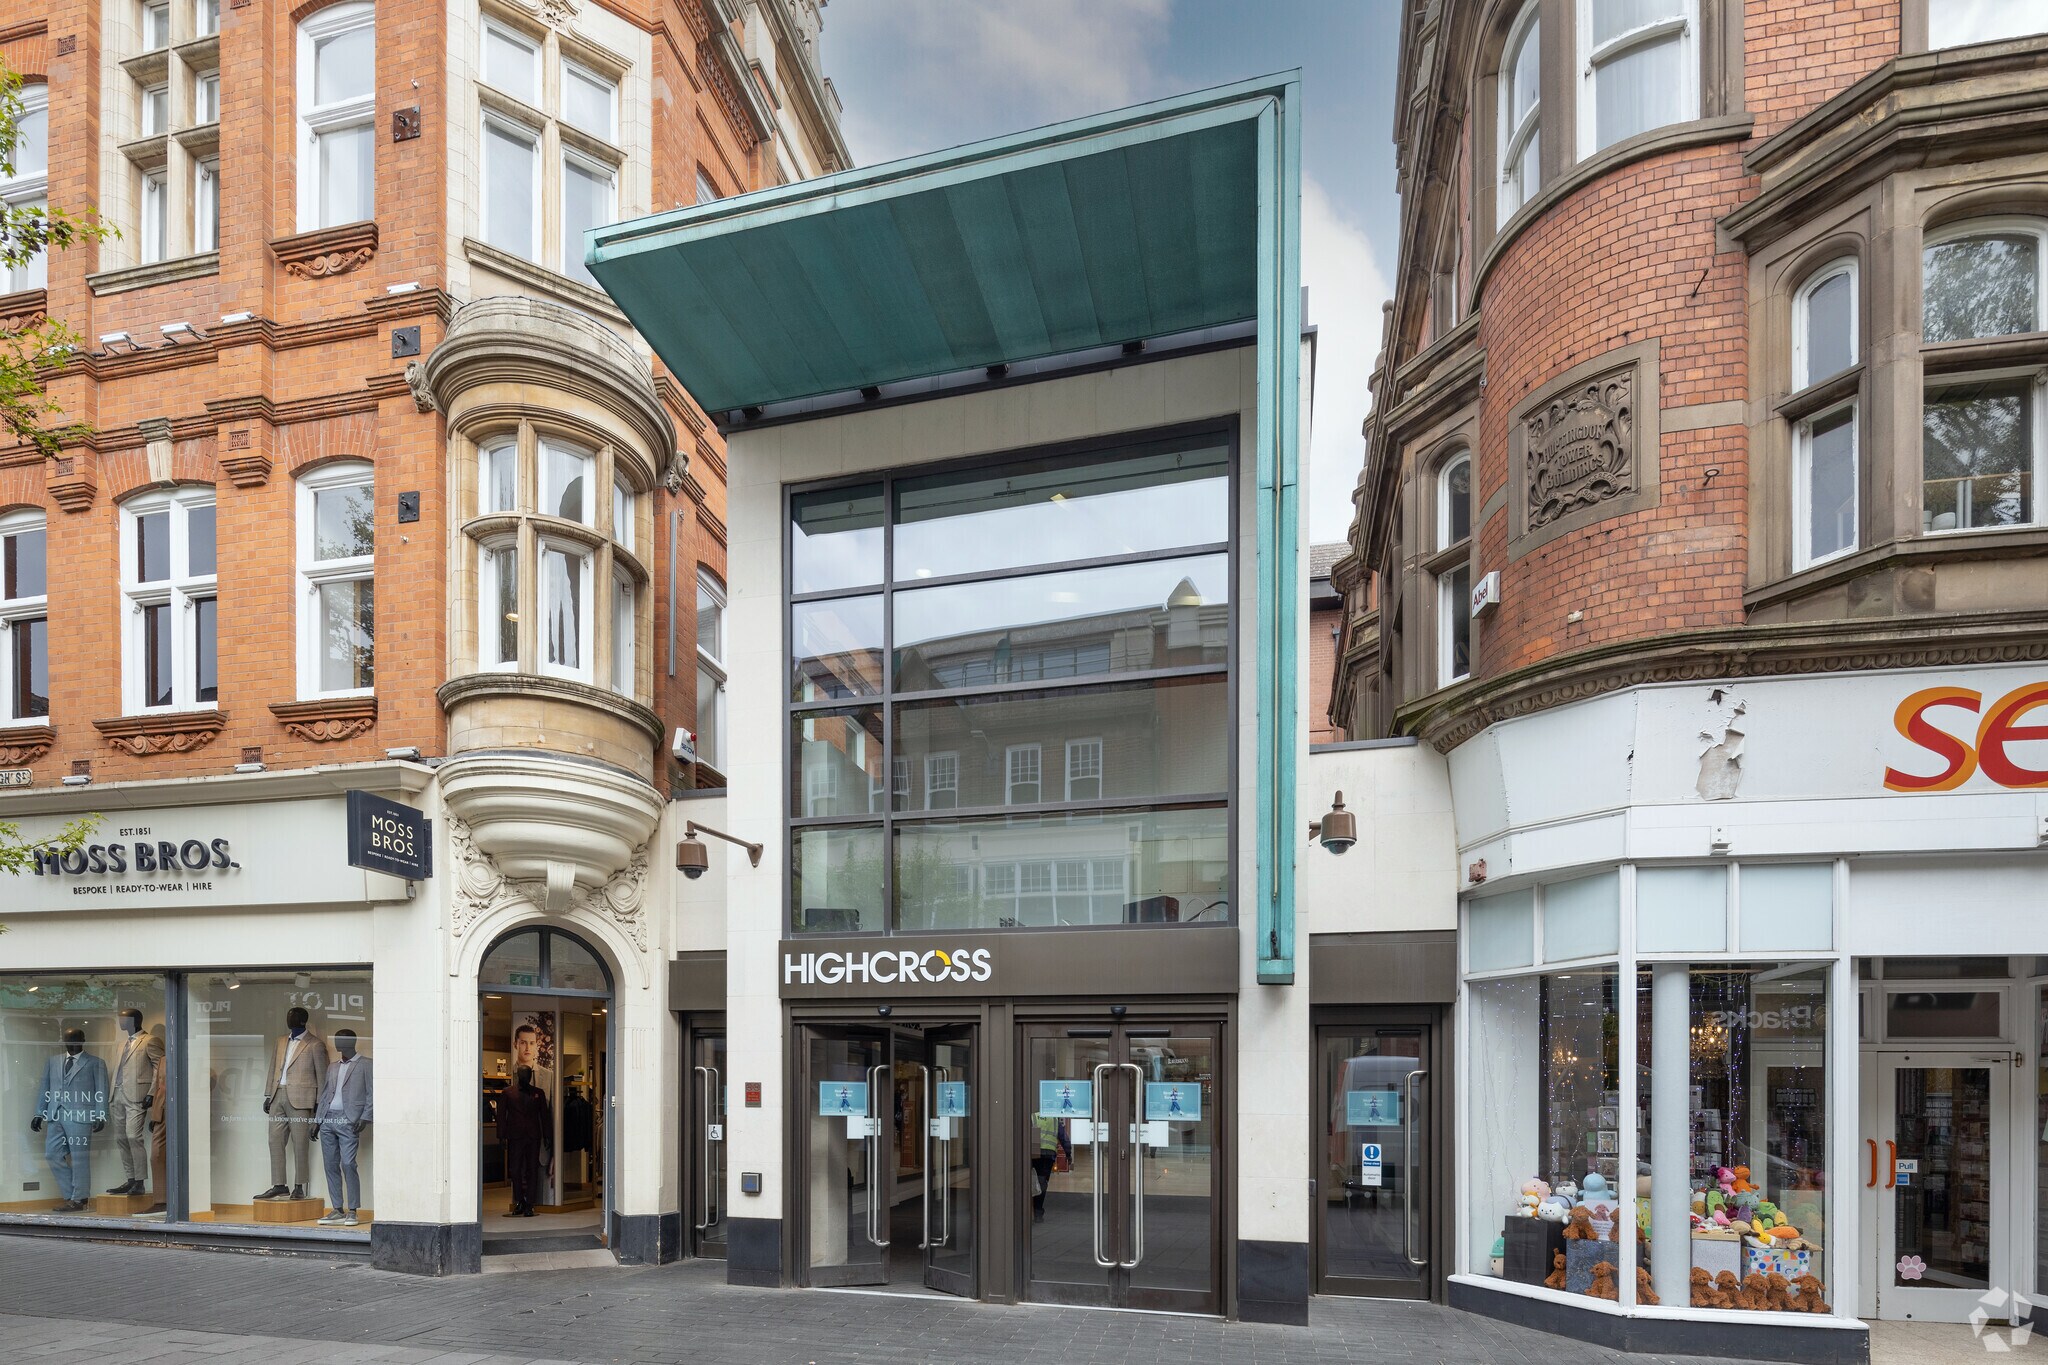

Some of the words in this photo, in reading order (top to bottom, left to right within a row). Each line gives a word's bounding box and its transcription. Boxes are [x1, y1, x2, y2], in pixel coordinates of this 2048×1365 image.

[1543, 424, 1606, 463] HUNTINGDON
[1555, 445, 1592, 471] TOWER
[1546, 454, 1605, 489] BUILDINGS
[1473, 582, 1488, 609] Abel
[119, 827, 151, 837] EST.1851
[372, 814, 413, 839] MOSS
[33, 843, 127, 876] MOSS
[135, 838, 241, 872] BROS.
[367, 850, 382, 858] BESPOKE
[372, 832, 418, 858] BROS.
[73, 885, 107, 895] BESPOKE
[116, 883, 184, 894] READY-TO-WEAR
[192, 882, 213, 891] HIRE
[784, 948, 992, 984] HIGHCROSS
[44, 1090, 104, 1103] SPRING
[42, 1109, 107, 1122] SUMMER
[61, 1136, 88, 1146] 2022
[1899, 1162, 1914, 1170] Pull
